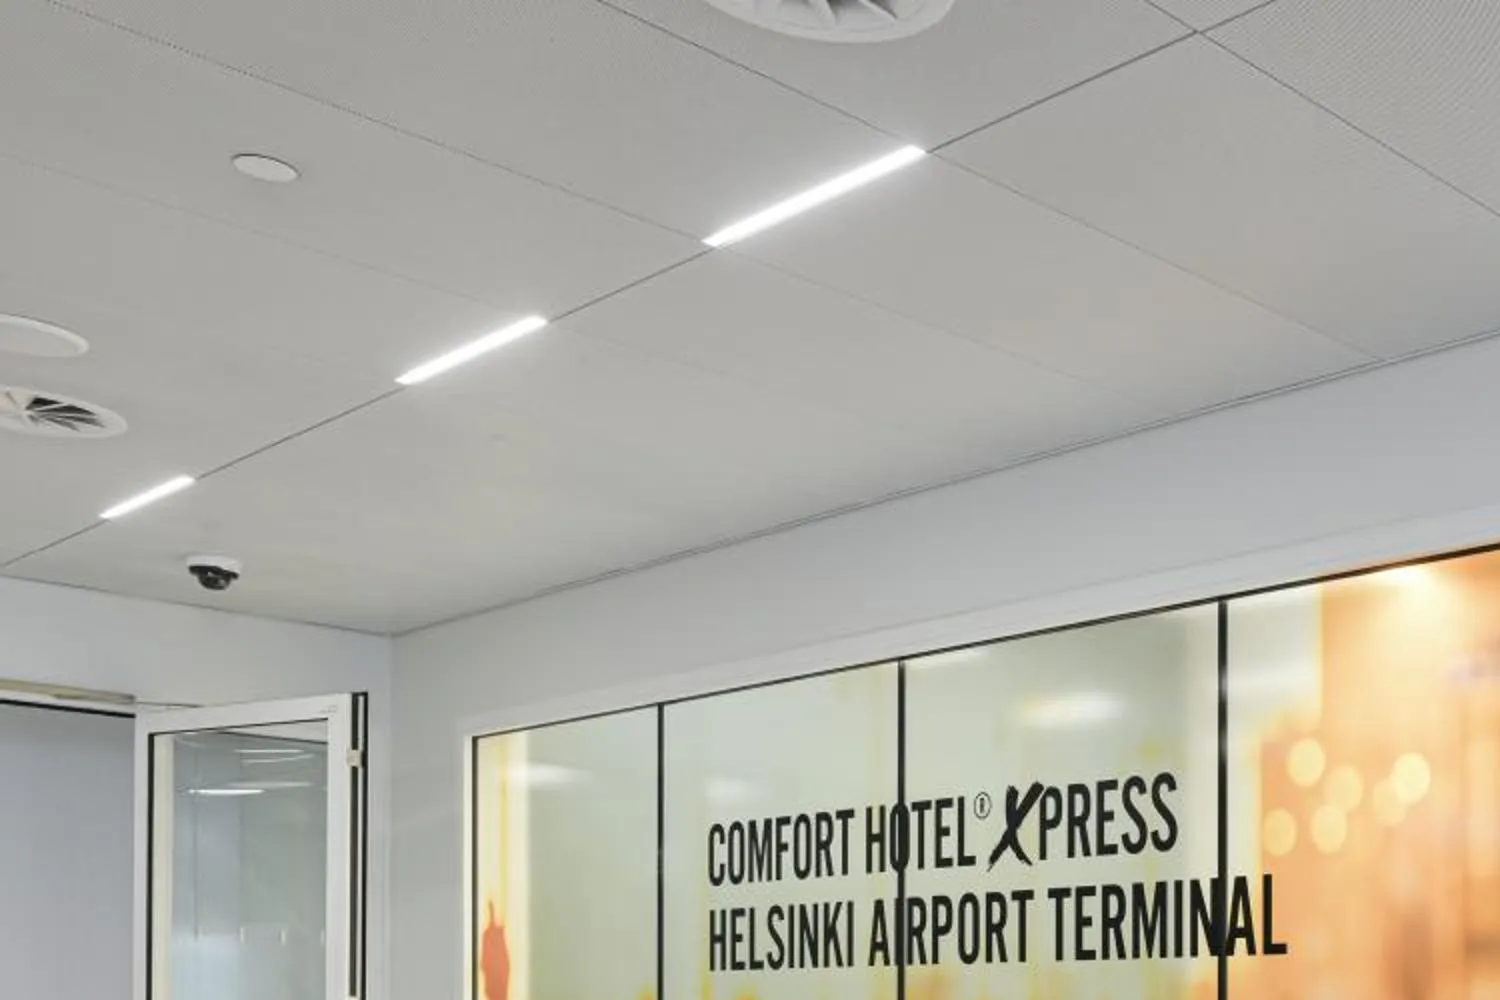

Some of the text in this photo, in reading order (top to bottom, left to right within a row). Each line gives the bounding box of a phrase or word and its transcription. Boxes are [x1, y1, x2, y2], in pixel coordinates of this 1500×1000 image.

[707, 809, 855, 887] COMFORT
[986, 772, 1179, 872] XPRESS
[709, 873, 1288, 972] HELSINKI AIRPORT TERMINAL
